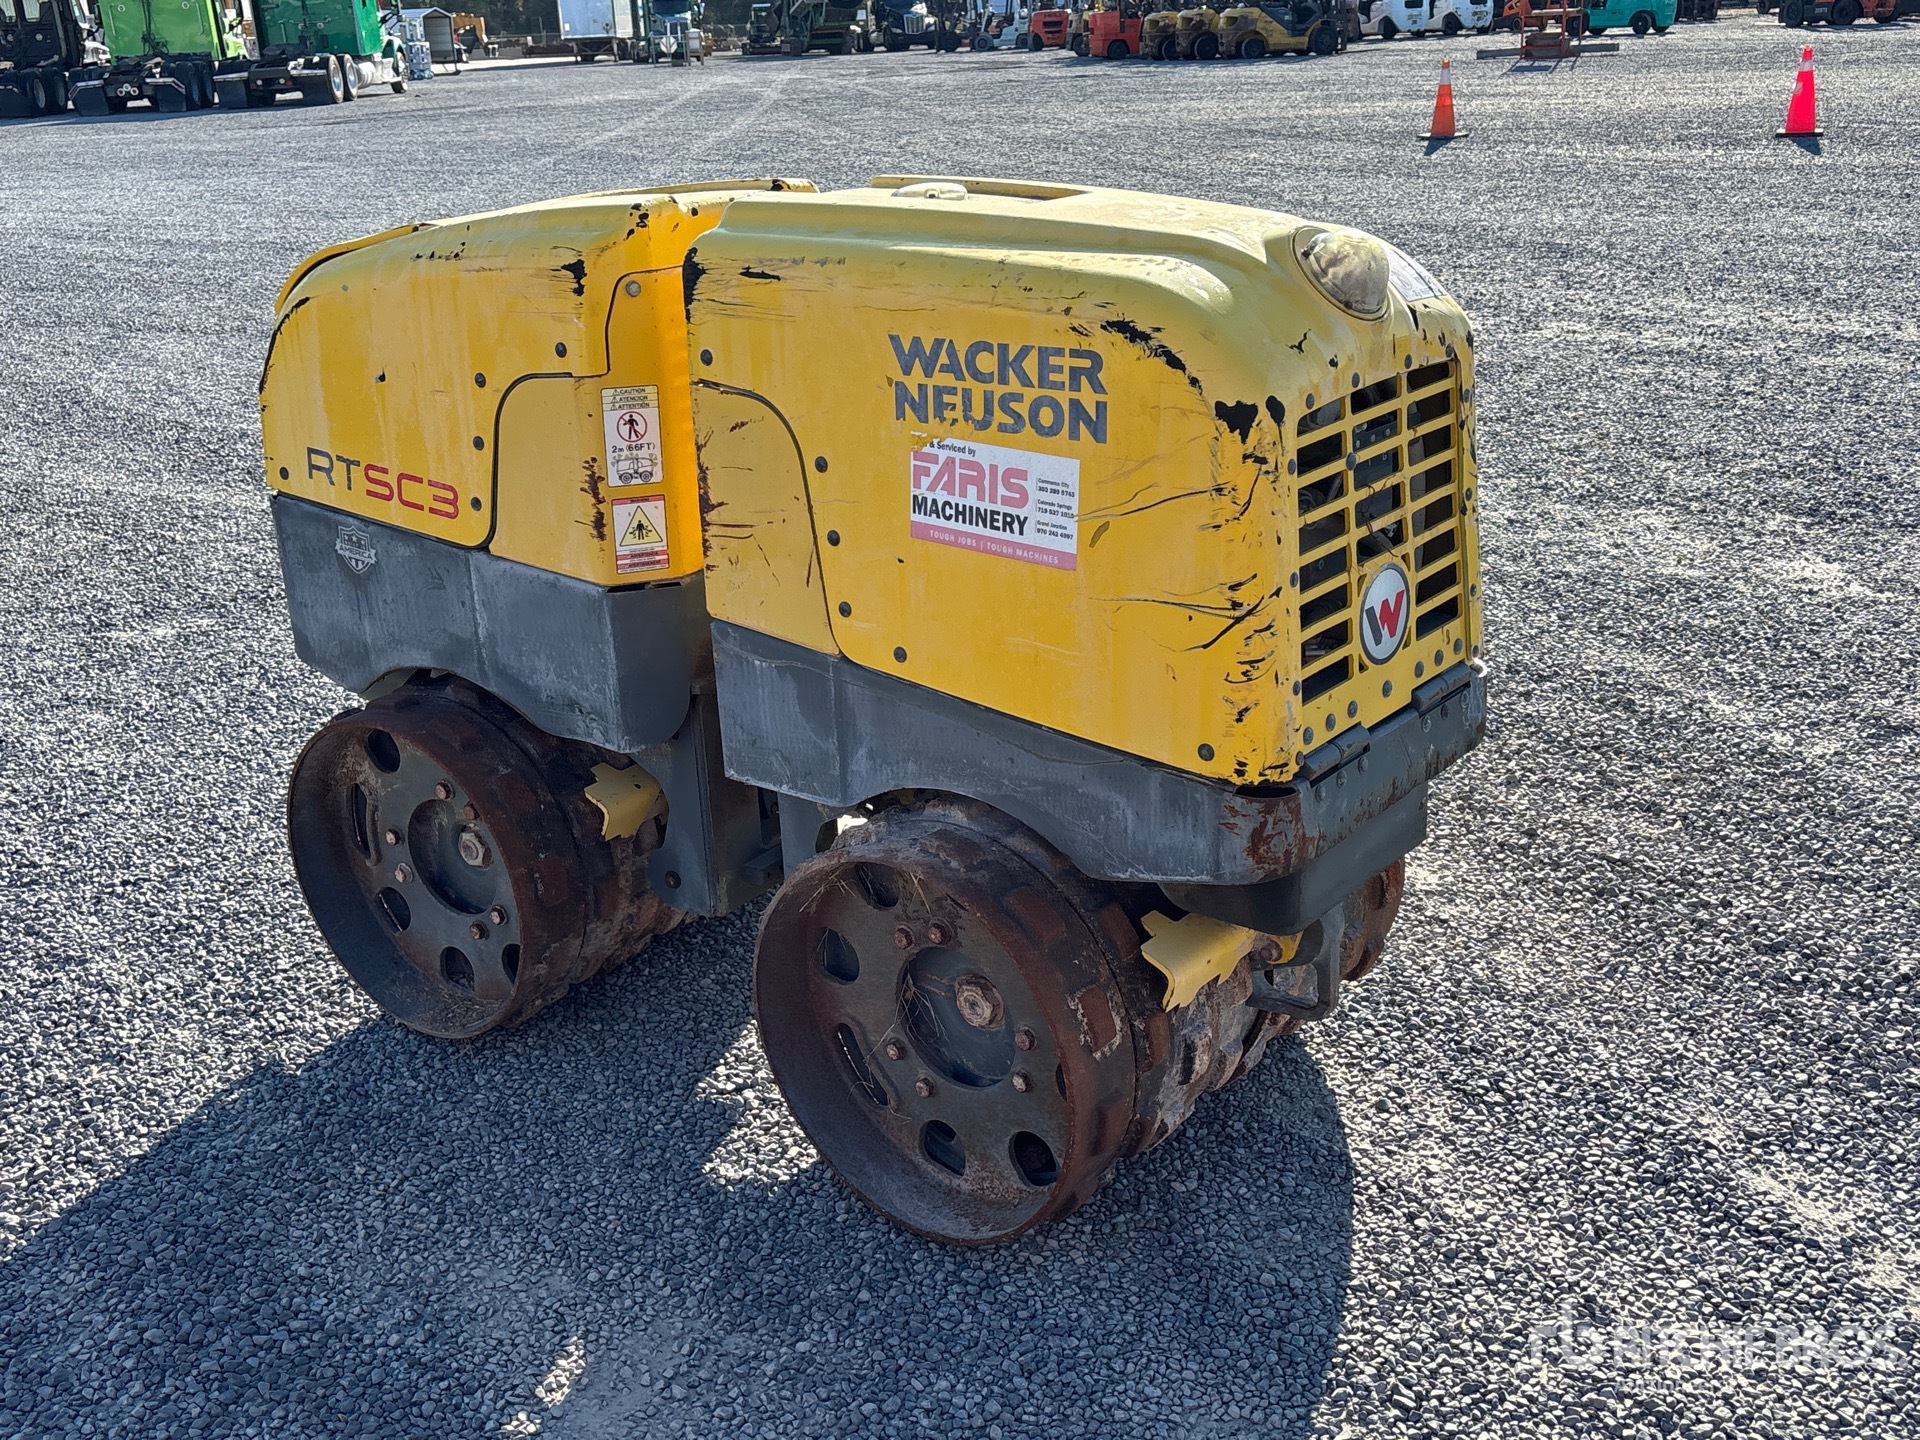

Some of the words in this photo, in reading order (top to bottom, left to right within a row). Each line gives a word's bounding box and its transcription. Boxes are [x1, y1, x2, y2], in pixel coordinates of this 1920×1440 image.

[887, 333, 1108, 395] WACKER
[894, 380, 1108, 444] NEUSON
[936, 440, 966, 455] Serviced
[968, 446, 977, 457] by
[912, 451, 1029, 509] FARIS
[912, 494, 1029, 536] MACHINERY
[929, 529, 955, 543] TOUGH
[957, 535, 977, 547] JOBS
[986, 541, 1014, 555] TOUGH
[1015, 545, 1060, 564] MACHINES
[1365, 589, 1405, 646] W
